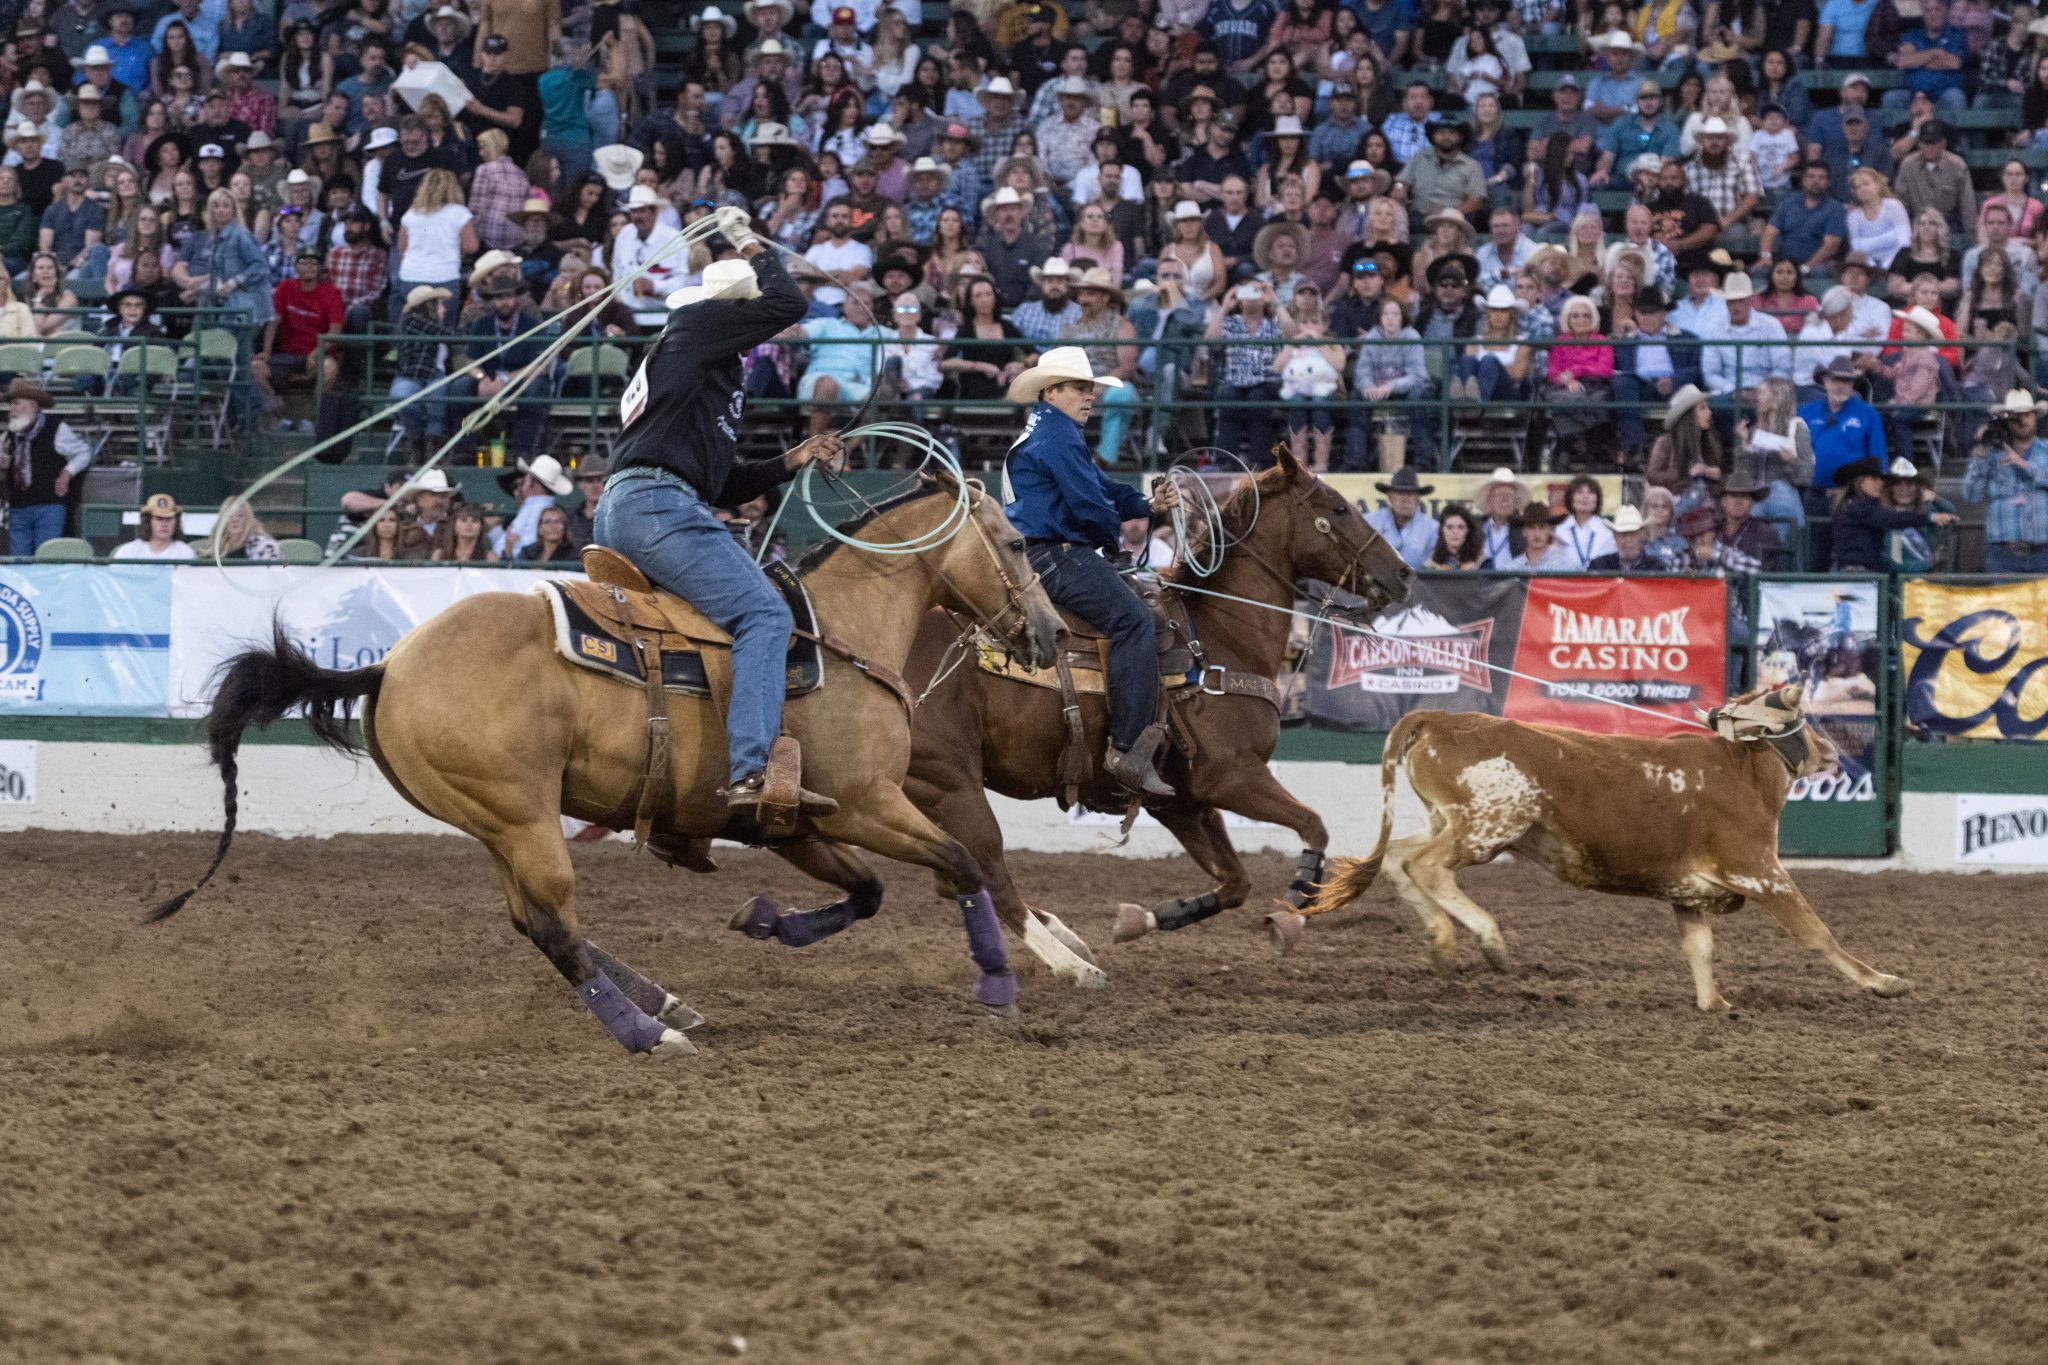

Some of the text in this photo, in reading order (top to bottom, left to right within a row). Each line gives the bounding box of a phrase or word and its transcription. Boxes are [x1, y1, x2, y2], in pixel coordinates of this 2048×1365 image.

[16, 600, 40, 650] SUPPLY
[1549, 603, 1690, 645] TAMARACK
[584, 636, 615, 657] CSI
[1550, 646, 1689, 673] CASINO
[1378, 678, 1443, 690] CASINO
[1396, 666, 1424, 678] INN
[1549, 682, 1692, 699] YOUR GOOD TIMES!
[1962, 809, 2048, 857] RENO
